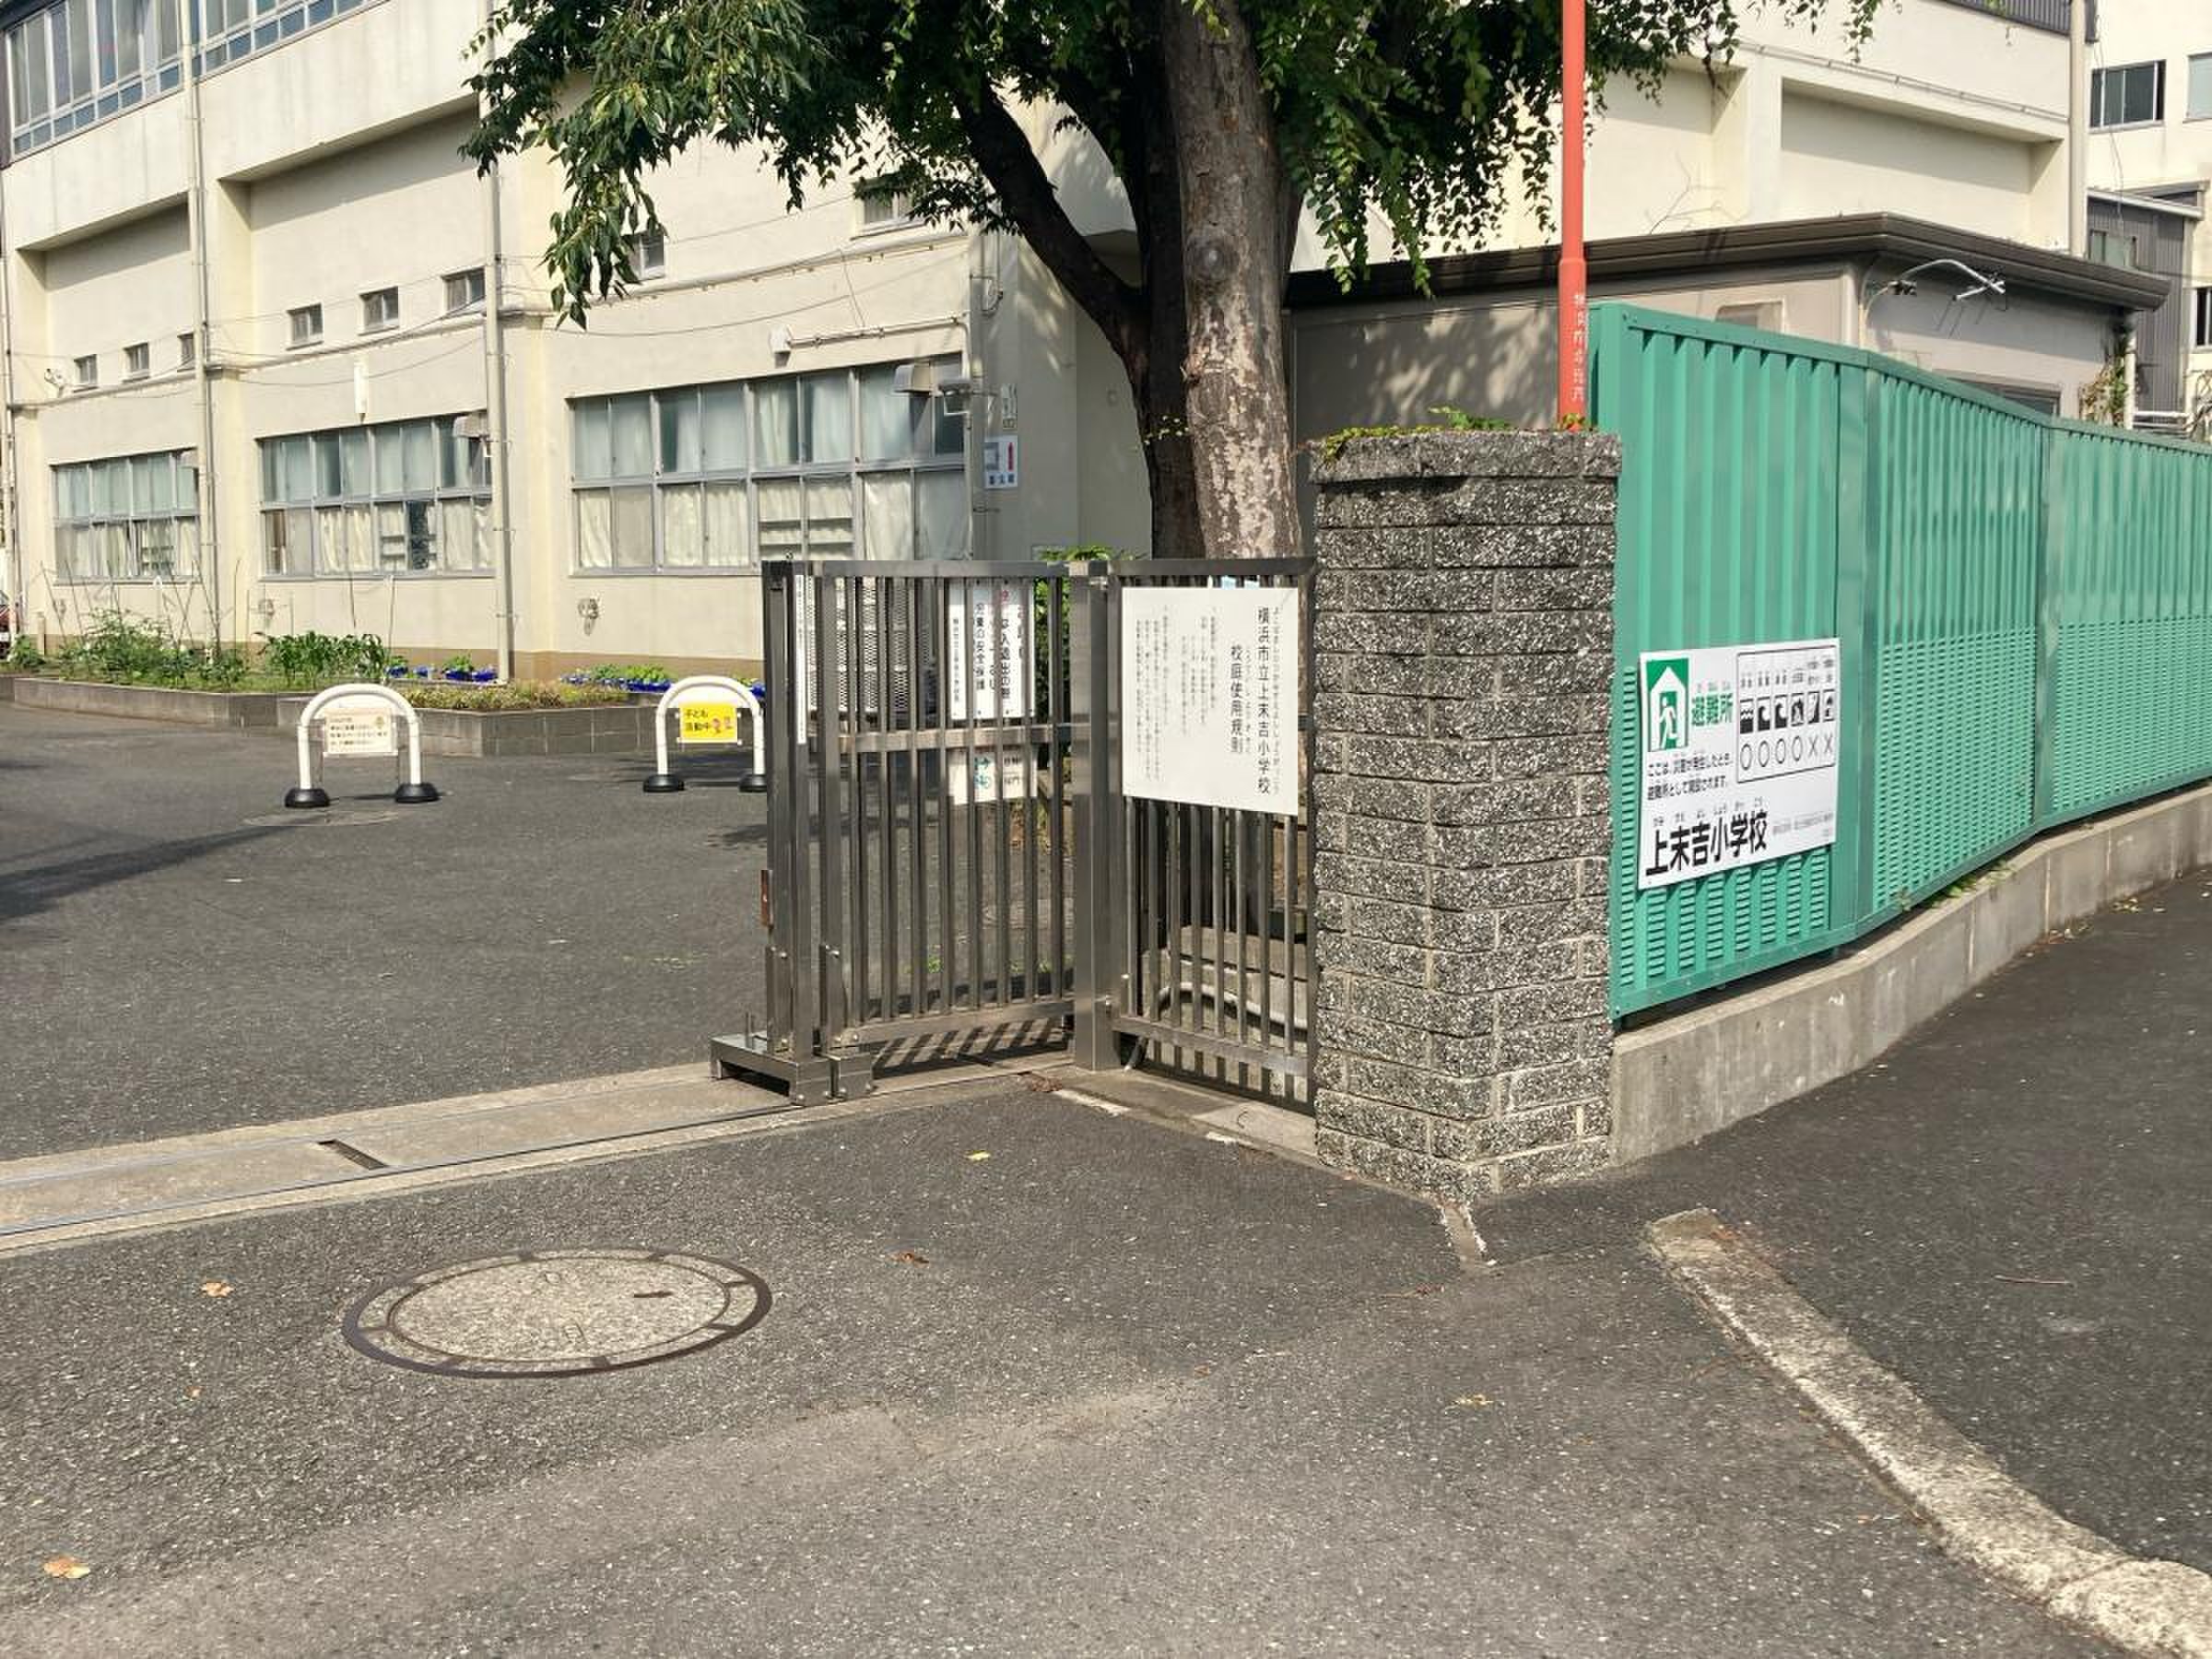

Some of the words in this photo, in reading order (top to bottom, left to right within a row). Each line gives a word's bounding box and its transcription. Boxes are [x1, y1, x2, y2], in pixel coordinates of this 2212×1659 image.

[1230, 644, 1243, 754] 校庭使用規則
[1257, 606, 1270, 795] 横浜市立上末吉小学校
[1691, 692, 1734, 726] 避難所
[1645, 809, 1768, 877] 上末吉小学校
